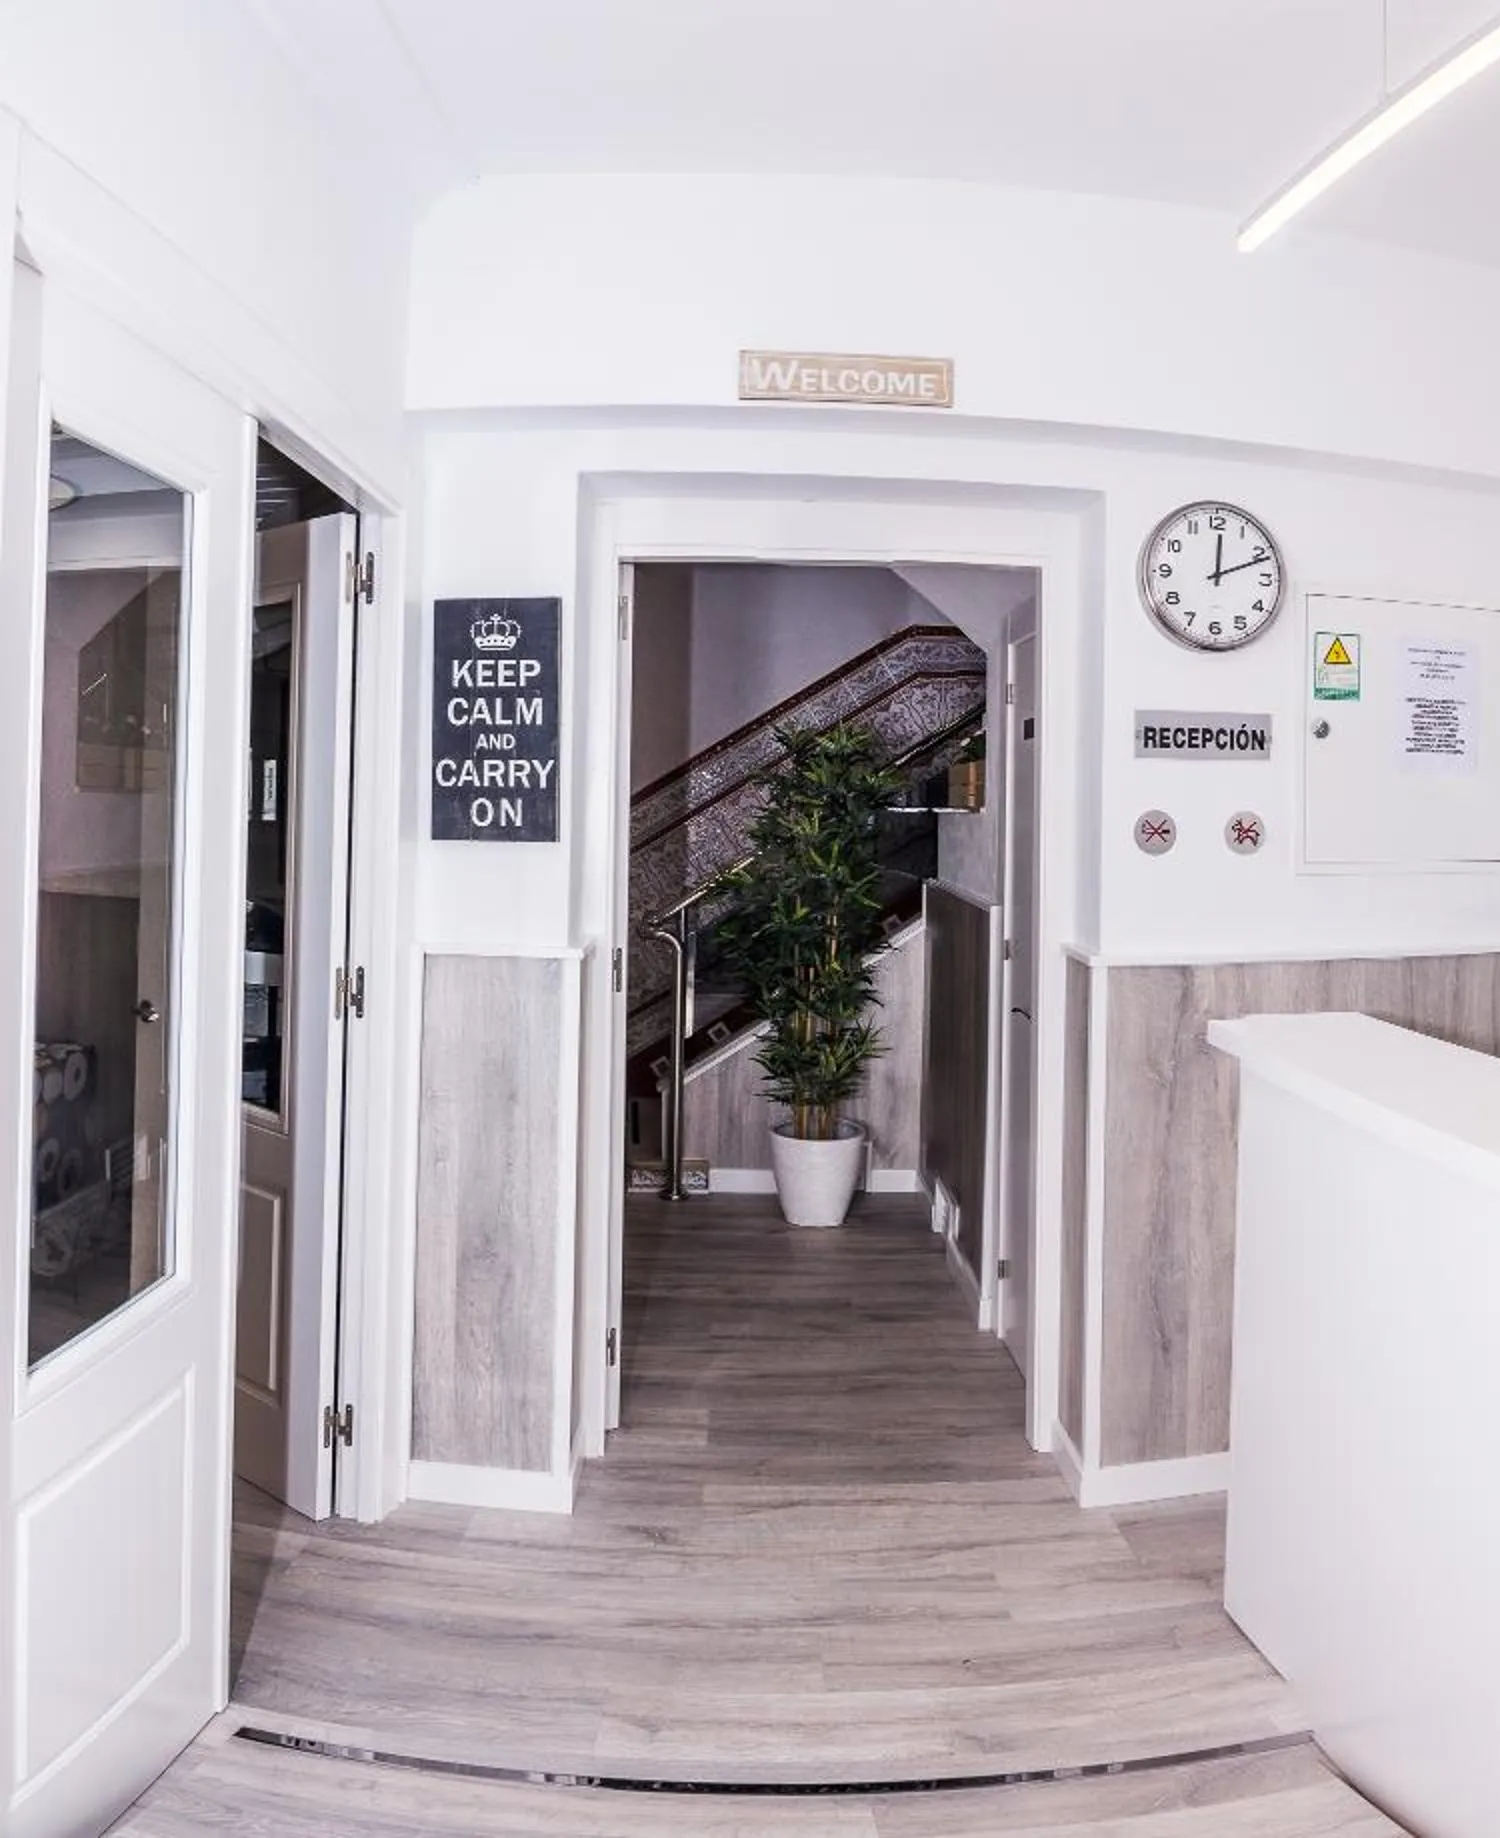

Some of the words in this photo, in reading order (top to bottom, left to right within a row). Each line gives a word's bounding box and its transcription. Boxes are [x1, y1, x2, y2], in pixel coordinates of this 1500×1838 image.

[750, 358, 938, 396] WELCOME
[1187, 520, 1199, 534] 11
[1209, 516, 1226, 531] 12
[1167, 539, 1181, 553] 10
[1252, 546, 1266, 561] 2
[1159, 564, 1172, 579] 9
[1258, 573, 1273, 587] 3
[1165, 592, 1180, 605] 8
[1251, 600, 1264, 613] 4
[1184, 612, 1197, 627] 7
[1233, 616, 1247, 630] 5
[1208, 621, 1222, 635] 6
[451, 659, 541, 688] KEEP
[447, 697, 543, 726] CALM
[476, 733, 516, 750] AND
[1143, 724, 1266, 751] RECEPCIÓN
[435, 759, 554, 789] CARRY
[470, 797, 523, 827] ON
